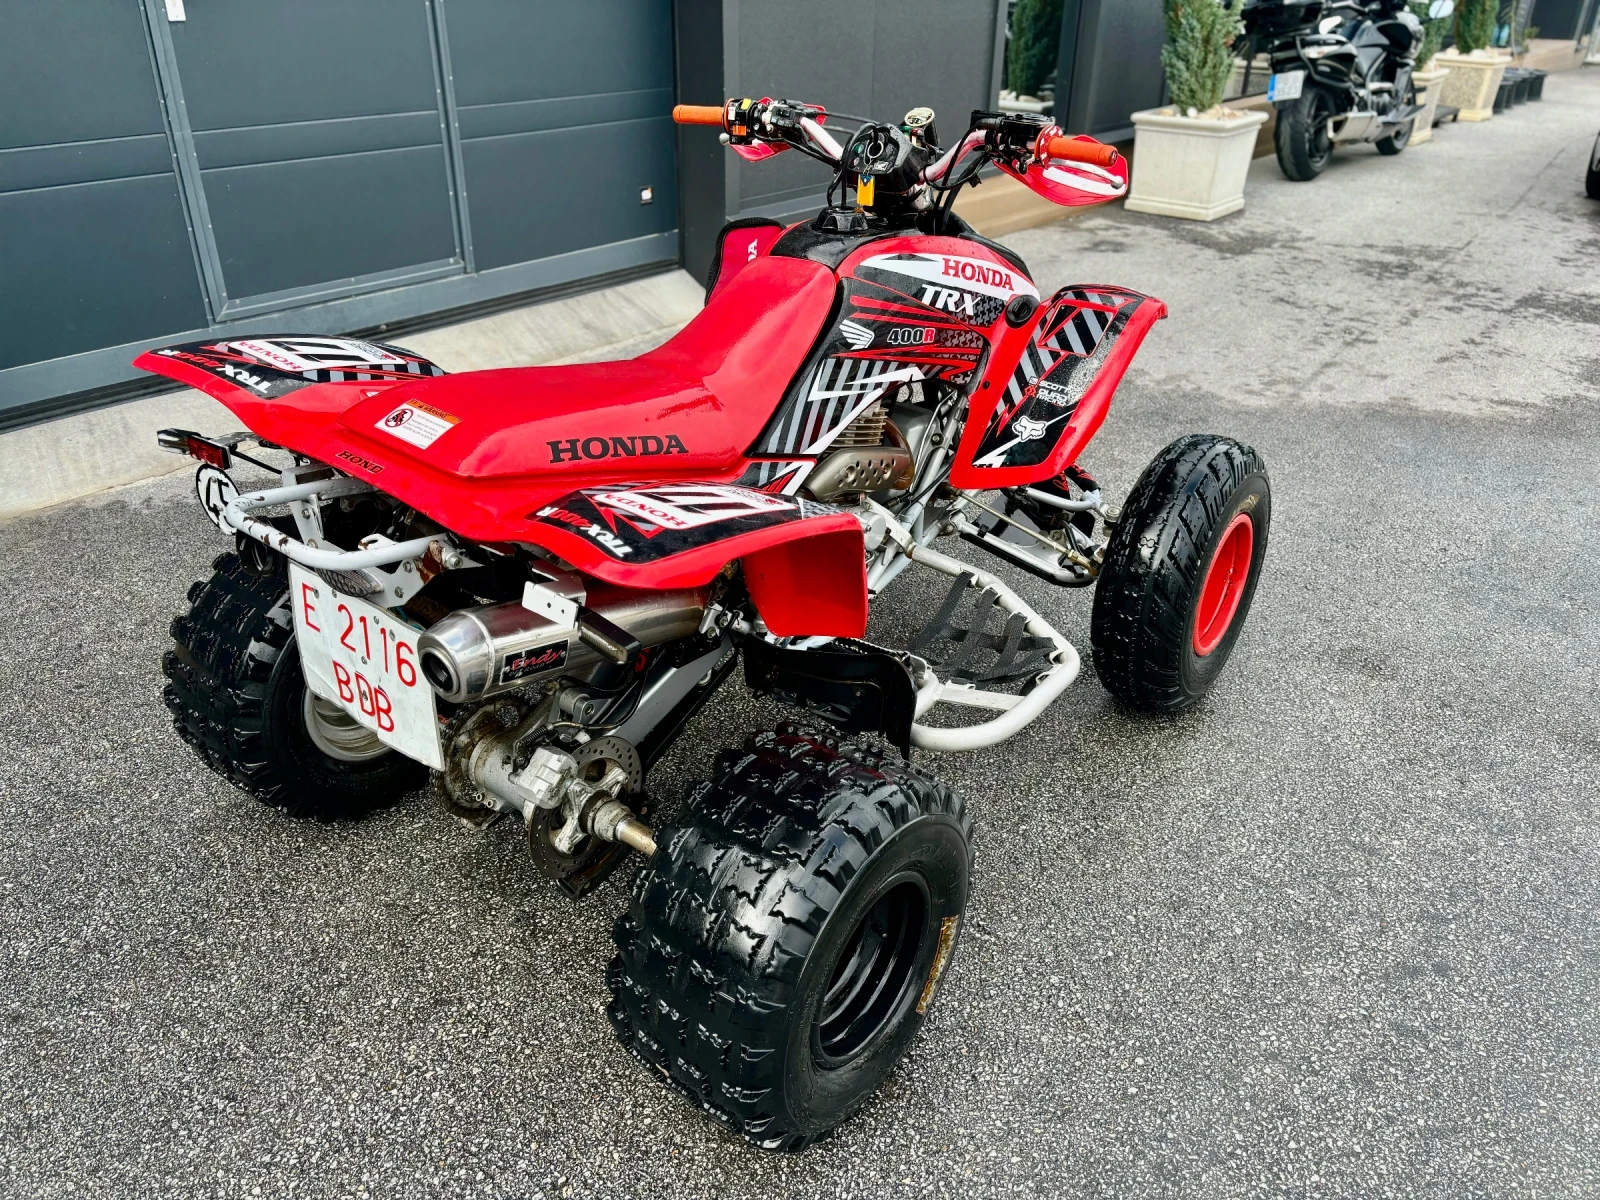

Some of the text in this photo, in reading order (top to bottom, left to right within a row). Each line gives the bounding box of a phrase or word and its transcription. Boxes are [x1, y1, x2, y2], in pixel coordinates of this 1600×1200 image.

[942, 257, 1015, 292] HONDA
[921, 283, 982, 316] TRX
[887, 327, 936, 345] 400R
[239, 341, 304, 371] HONDA
[1038, 388, 1068, 402] QUAD
[1039, 380, 1071, 394] SCOTT
[337, 450, 384, 474] HOND
[546, 434, 689, 464] HONDA
[604, 493, 690, 527] HONDA
[302, 582, 417, 688] E 2116
[511, 648, 563, 671] Endy
[332, 660, 395, 733] BDB
